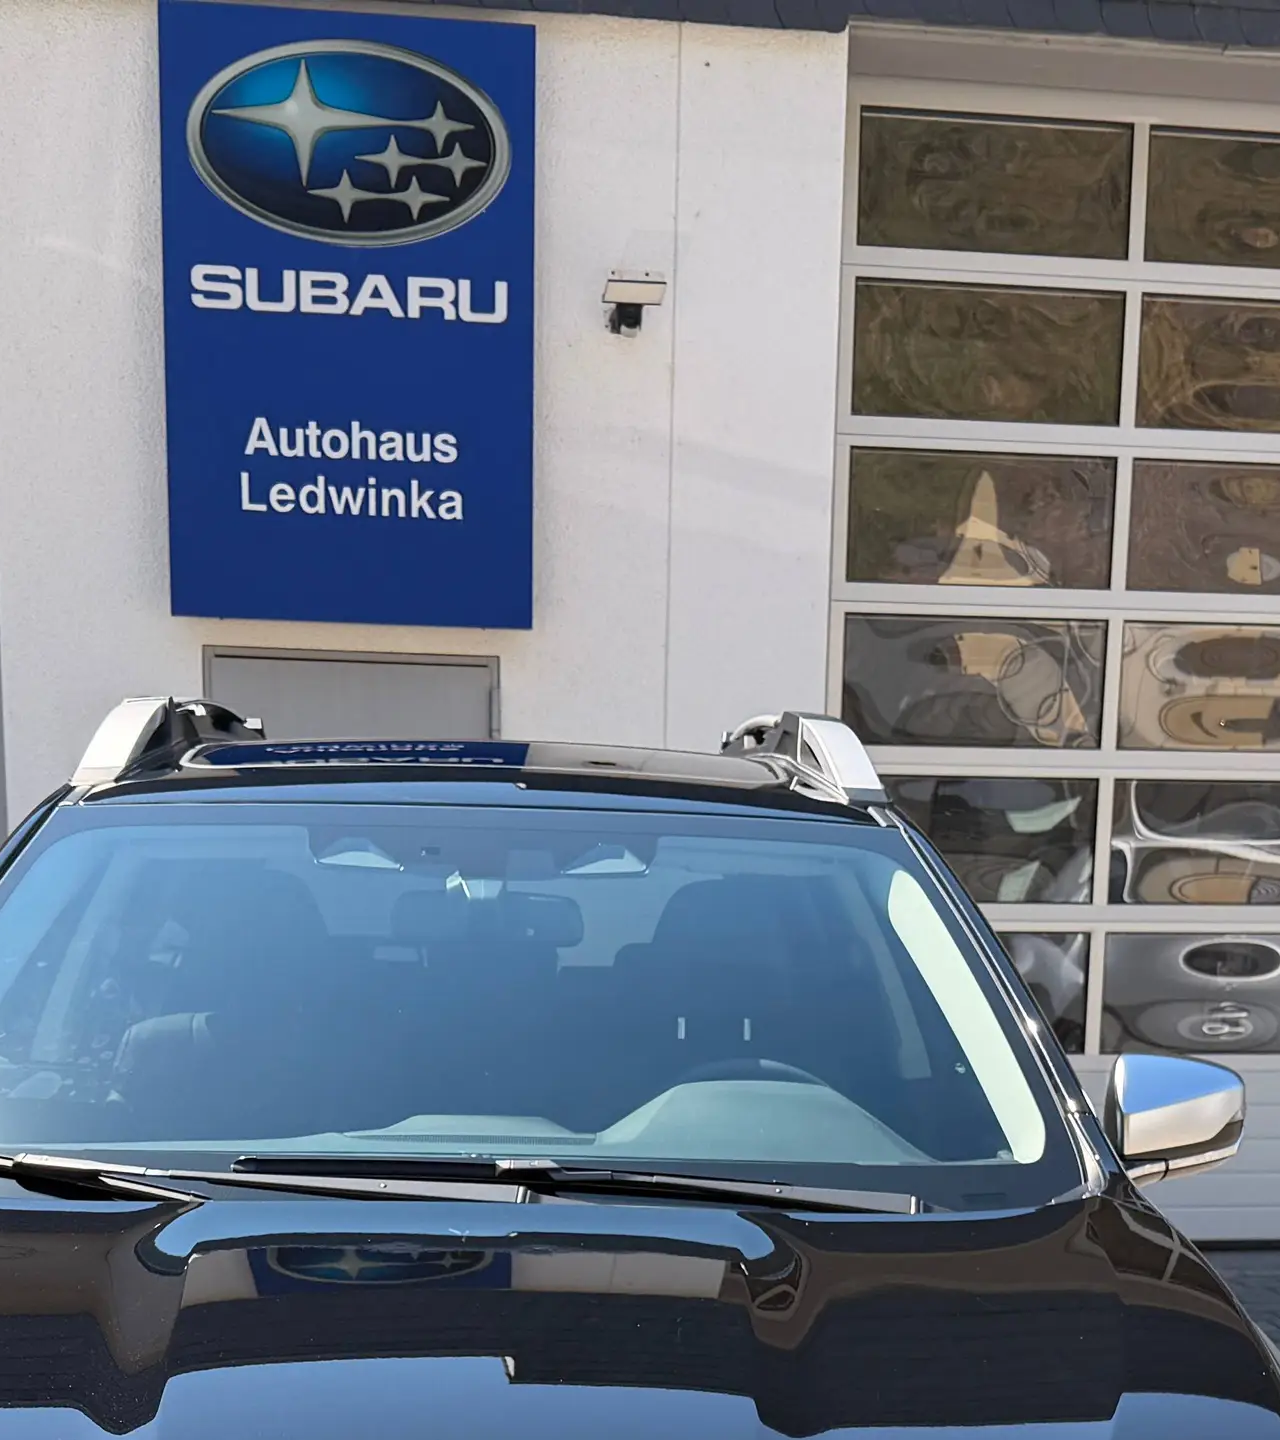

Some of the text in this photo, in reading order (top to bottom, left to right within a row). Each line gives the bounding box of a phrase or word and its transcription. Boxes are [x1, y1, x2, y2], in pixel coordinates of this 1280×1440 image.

[190, 264, 508, 324] SUBARU
[244, 417, 459, 463] Autohaus
[240, 472, 464, 520] Ledwinka
